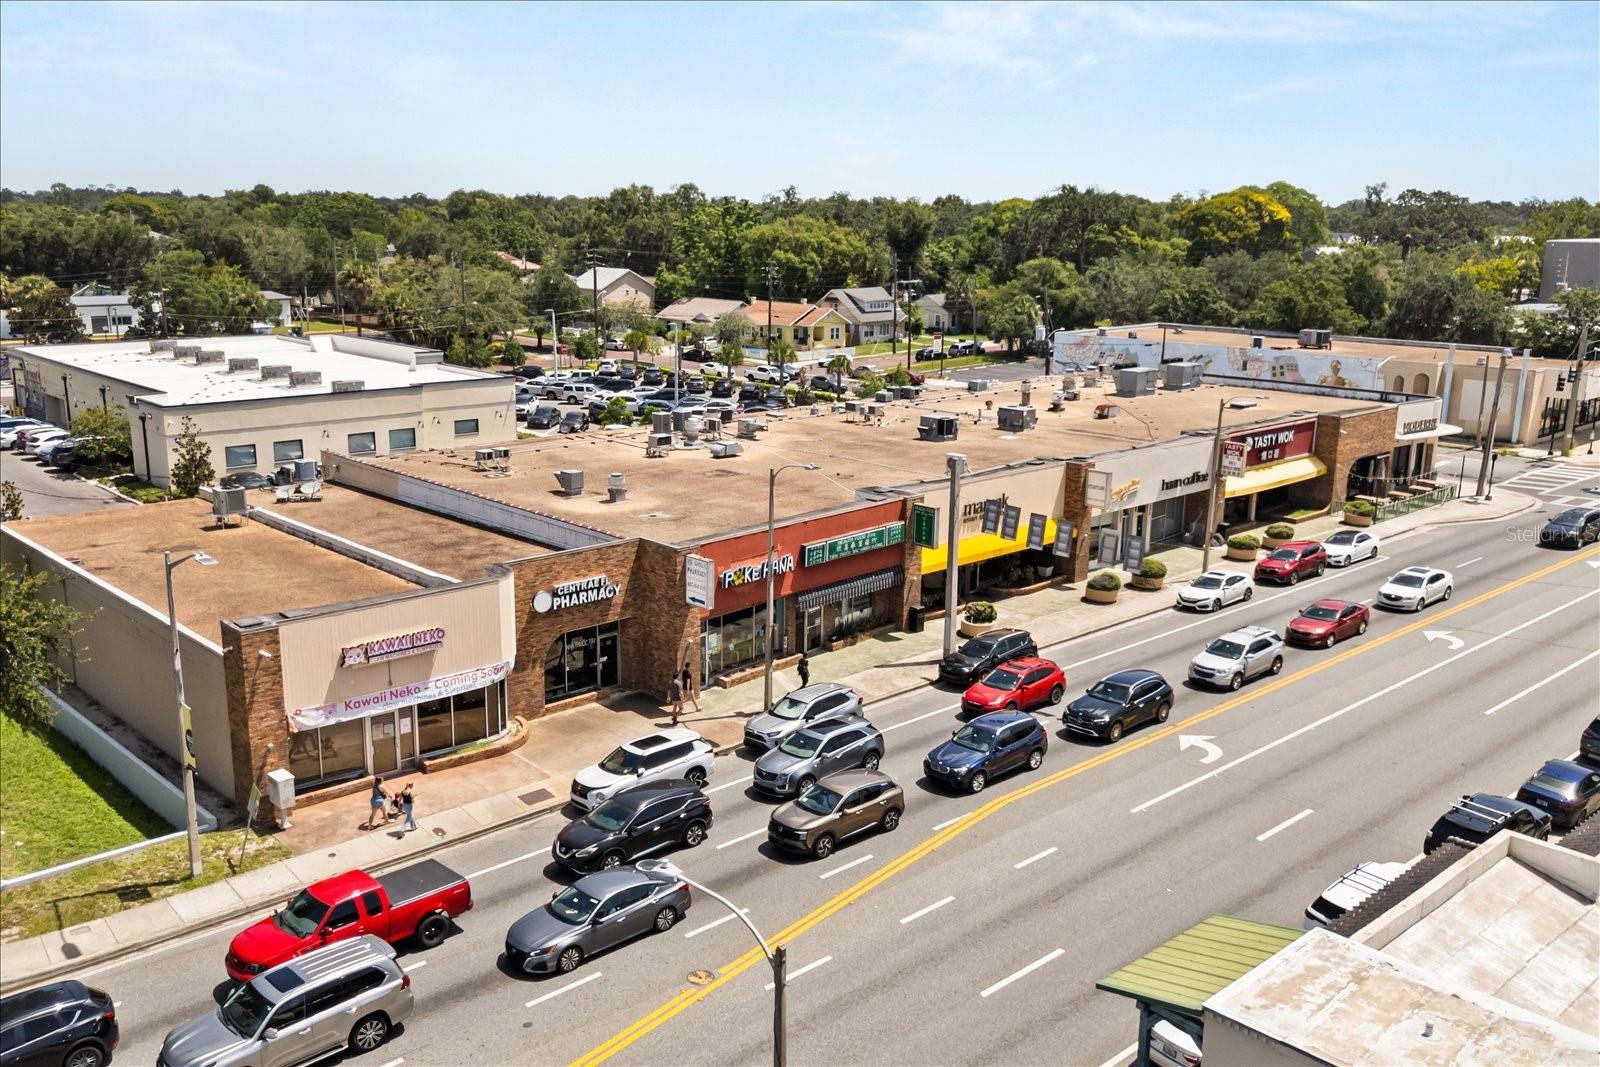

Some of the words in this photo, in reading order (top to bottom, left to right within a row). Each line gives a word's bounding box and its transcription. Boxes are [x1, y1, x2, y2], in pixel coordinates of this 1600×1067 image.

[1225, 443, 1243, 451] TASTY
[1254, 433, 1277, 448] TASTY
[1278, 430, 1295, 443] WOK
[963, 493, 1009, 516] mak
[553, 584, 621, 610] PHARMACY
[557, 580, 599, 595] CENTRAL
[368, 634, 412, 655] KAWAII
[414, 628, 445, 645] NEKO
[345, 691, 387, 711] Kawaii
[390, 685, 421, 700] Neko
[434, 672, 478, 689] Coming
[481, 665, 506, 679] Soon
